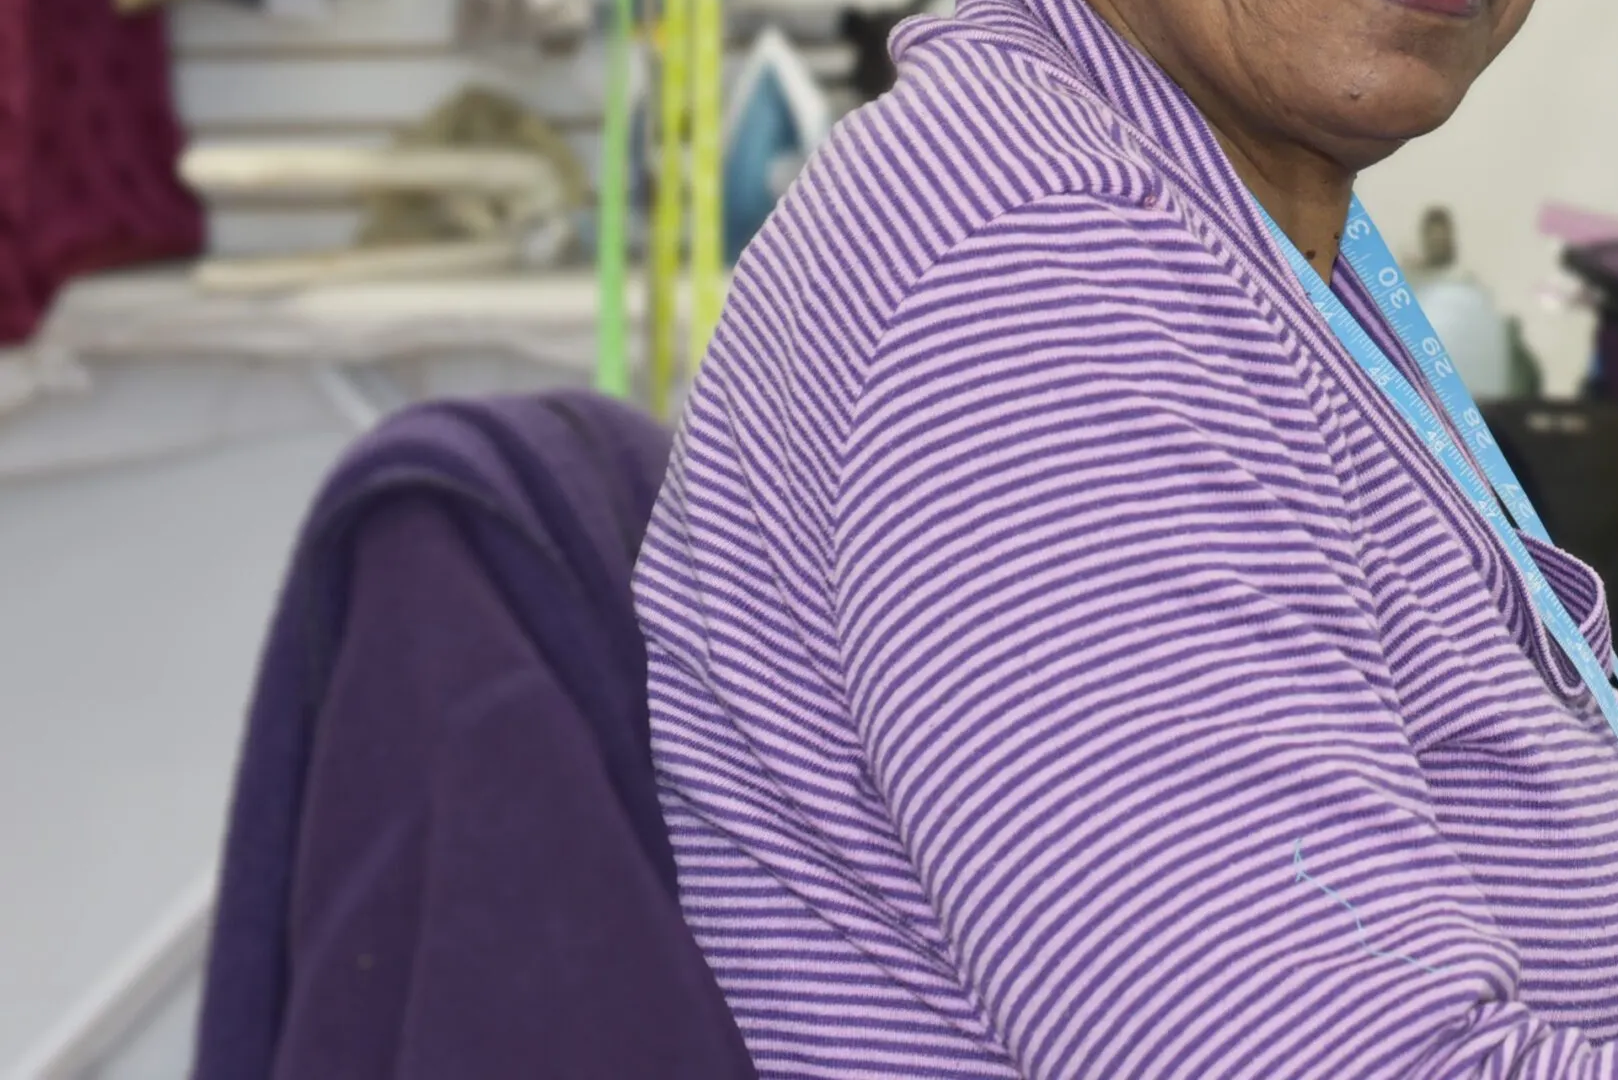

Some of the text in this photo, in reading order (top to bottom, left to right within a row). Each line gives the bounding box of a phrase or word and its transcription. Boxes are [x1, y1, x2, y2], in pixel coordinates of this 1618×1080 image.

[1378, 266, 1410, 309] 30
[1421, 336, 1454, 378] 29
[1314, 301, 1337, 322] 44
[1369, 366, 1391, 389] 45
[1427, 430, 1447, 454] 46
[1478, 500, 1498, 519] 47
[1463, 407, 1493, 449] 28
[1502, 483, 1535, 518] 27
